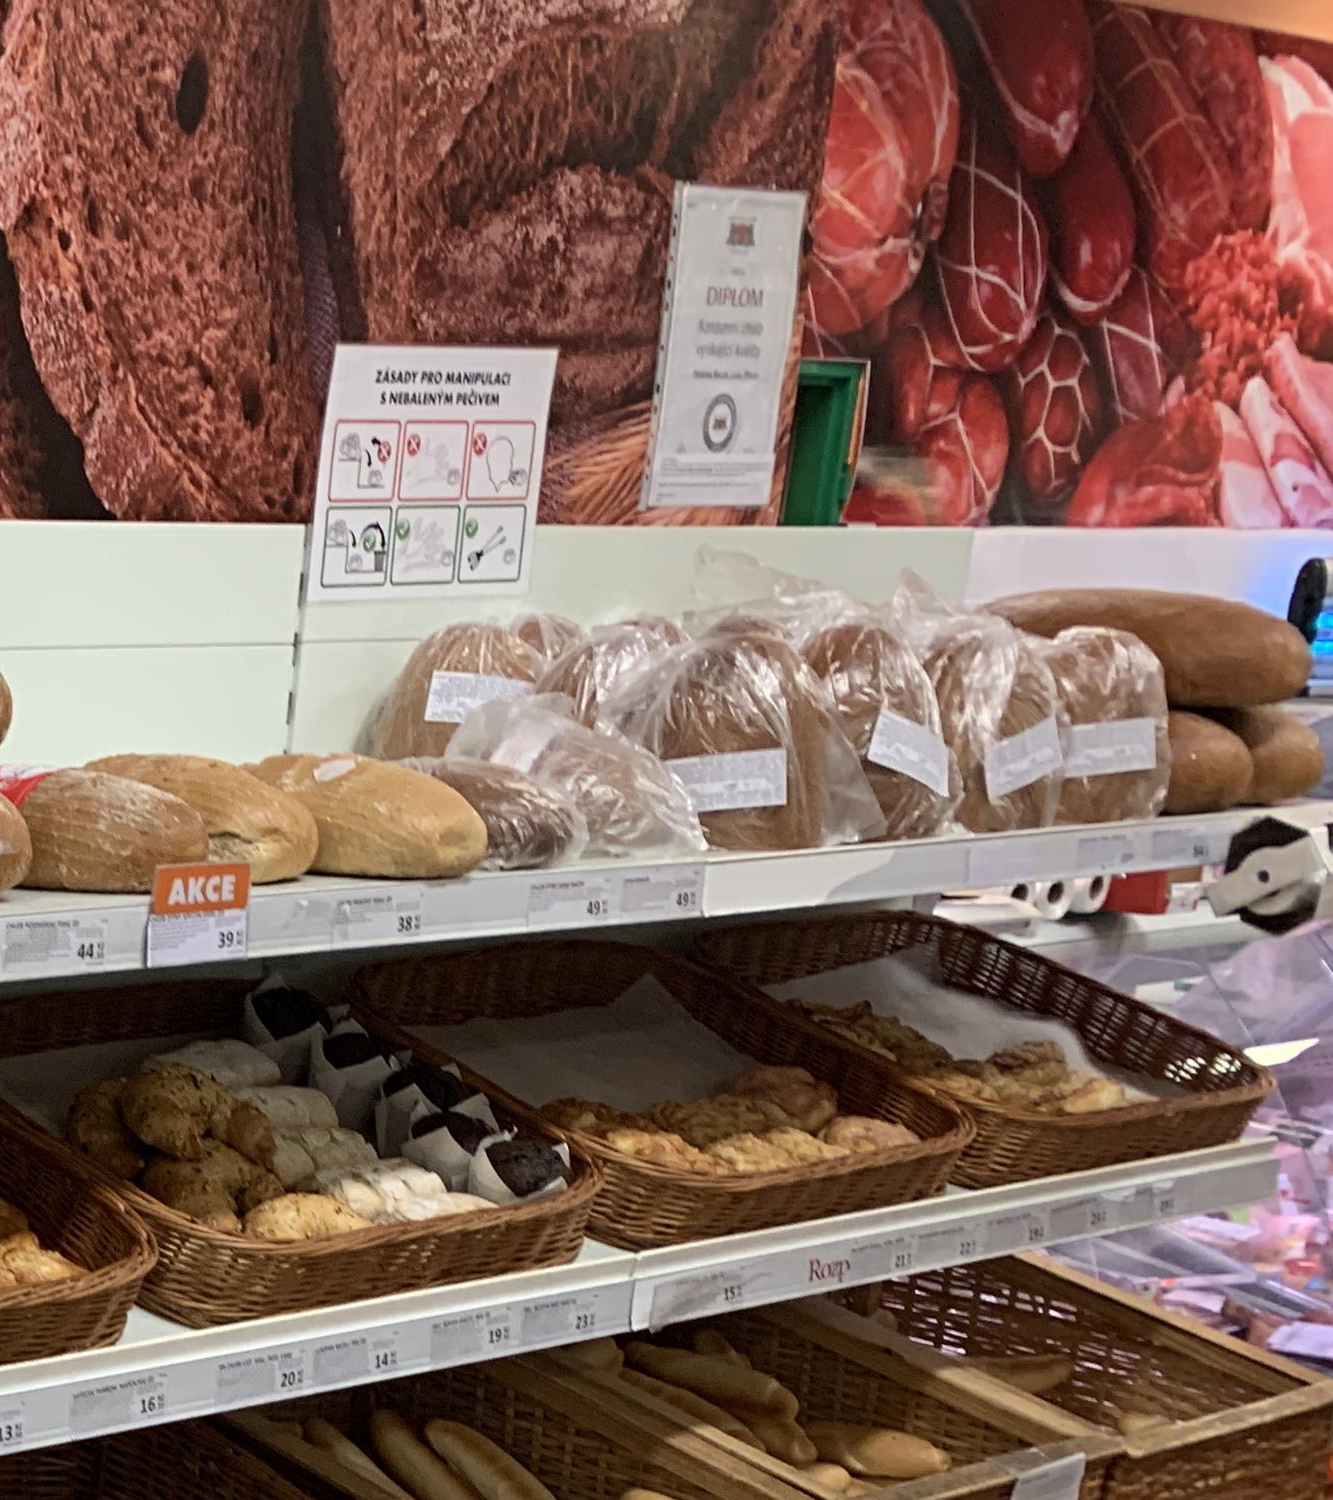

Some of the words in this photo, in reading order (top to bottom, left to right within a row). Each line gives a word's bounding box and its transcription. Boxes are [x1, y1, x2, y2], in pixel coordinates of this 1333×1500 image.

[706, 287, 763, 306] DIPLOM
[375, 369, 418, 385] ZÁSADY
[421, 371, 441, 384] PRO
[445, 371, 511, 386] MANIPULACI
[381, 392, 386, 405] S
[390, 389, 449, 405] NEBALENÝM
[454, 390, 500, 406] PEČIVEM
[168, 874, 236, 904] AKCE
[217, 932, 233, 948] 39
